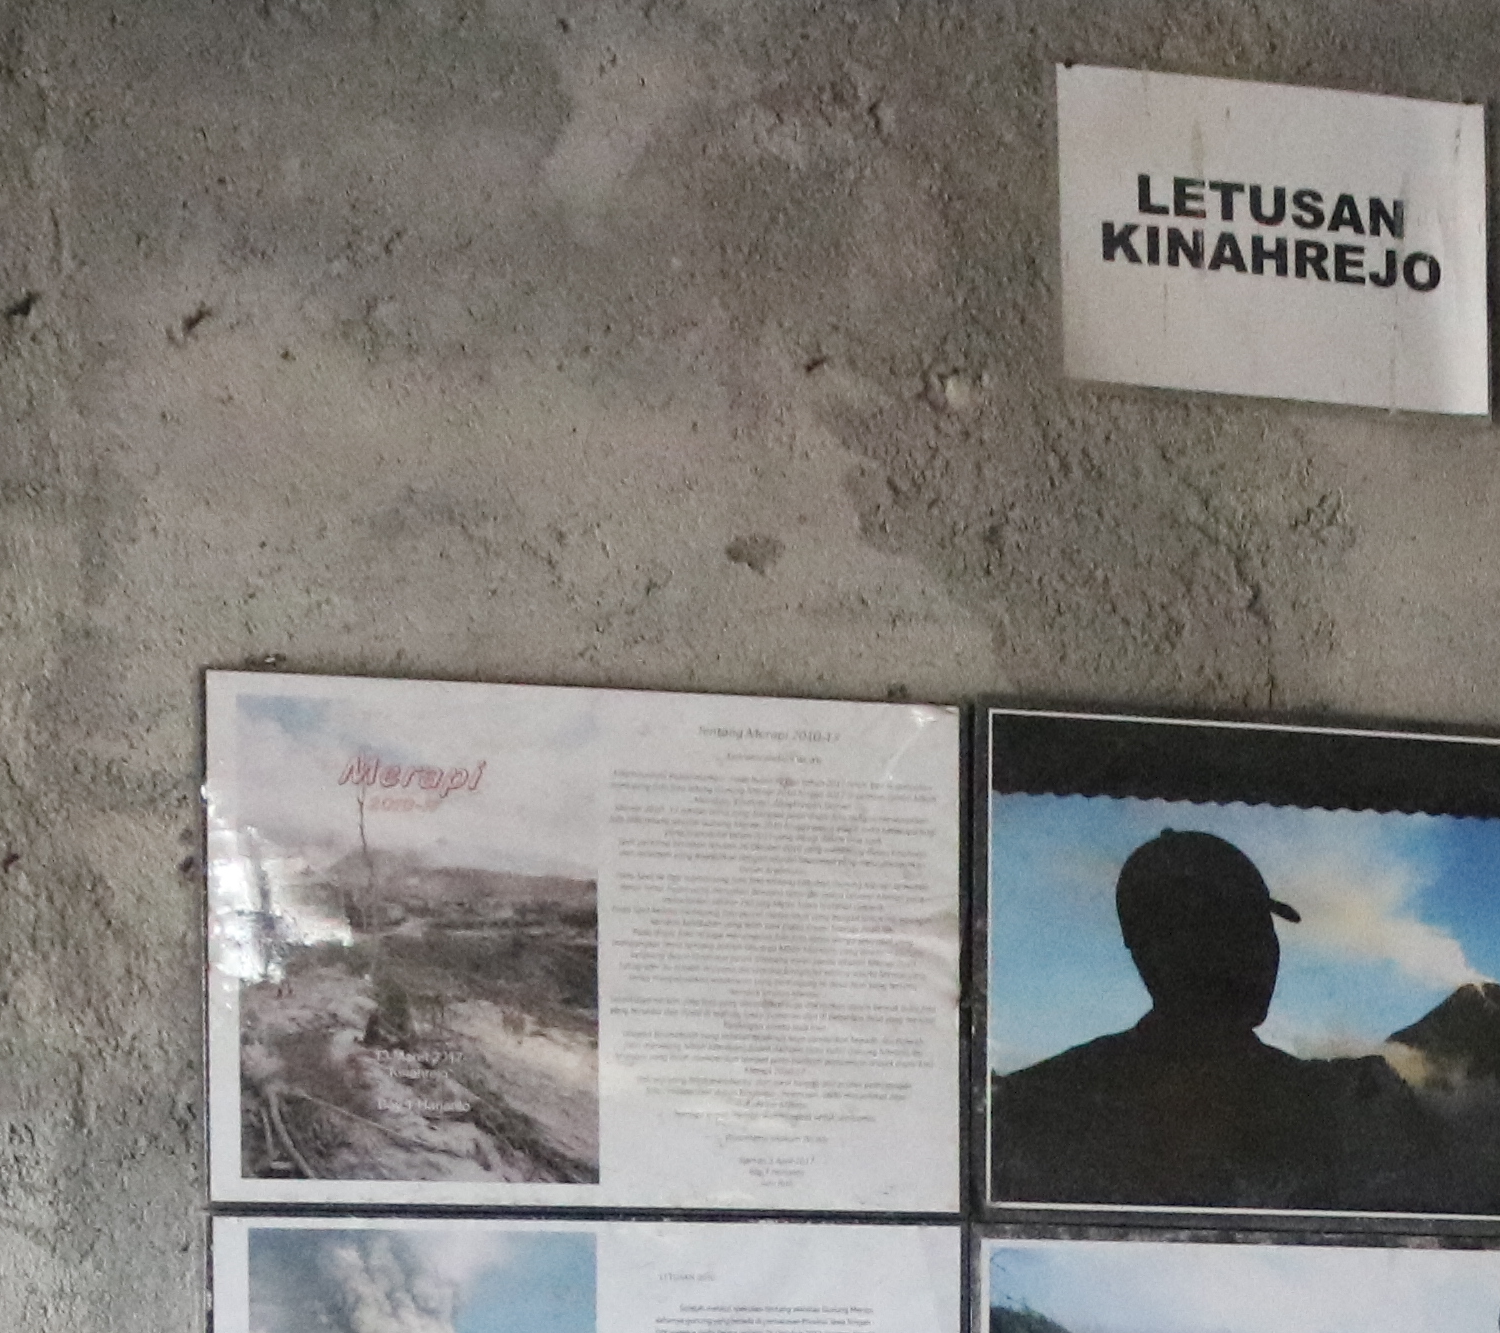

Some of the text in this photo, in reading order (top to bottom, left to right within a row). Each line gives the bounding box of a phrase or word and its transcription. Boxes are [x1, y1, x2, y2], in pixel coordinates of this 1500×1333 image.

[1137, 173, 1405, 241] LETUSAN
[1101, 220, 1442, 293] KINAHREJO
[338, 754, 486, 799] Merapi
